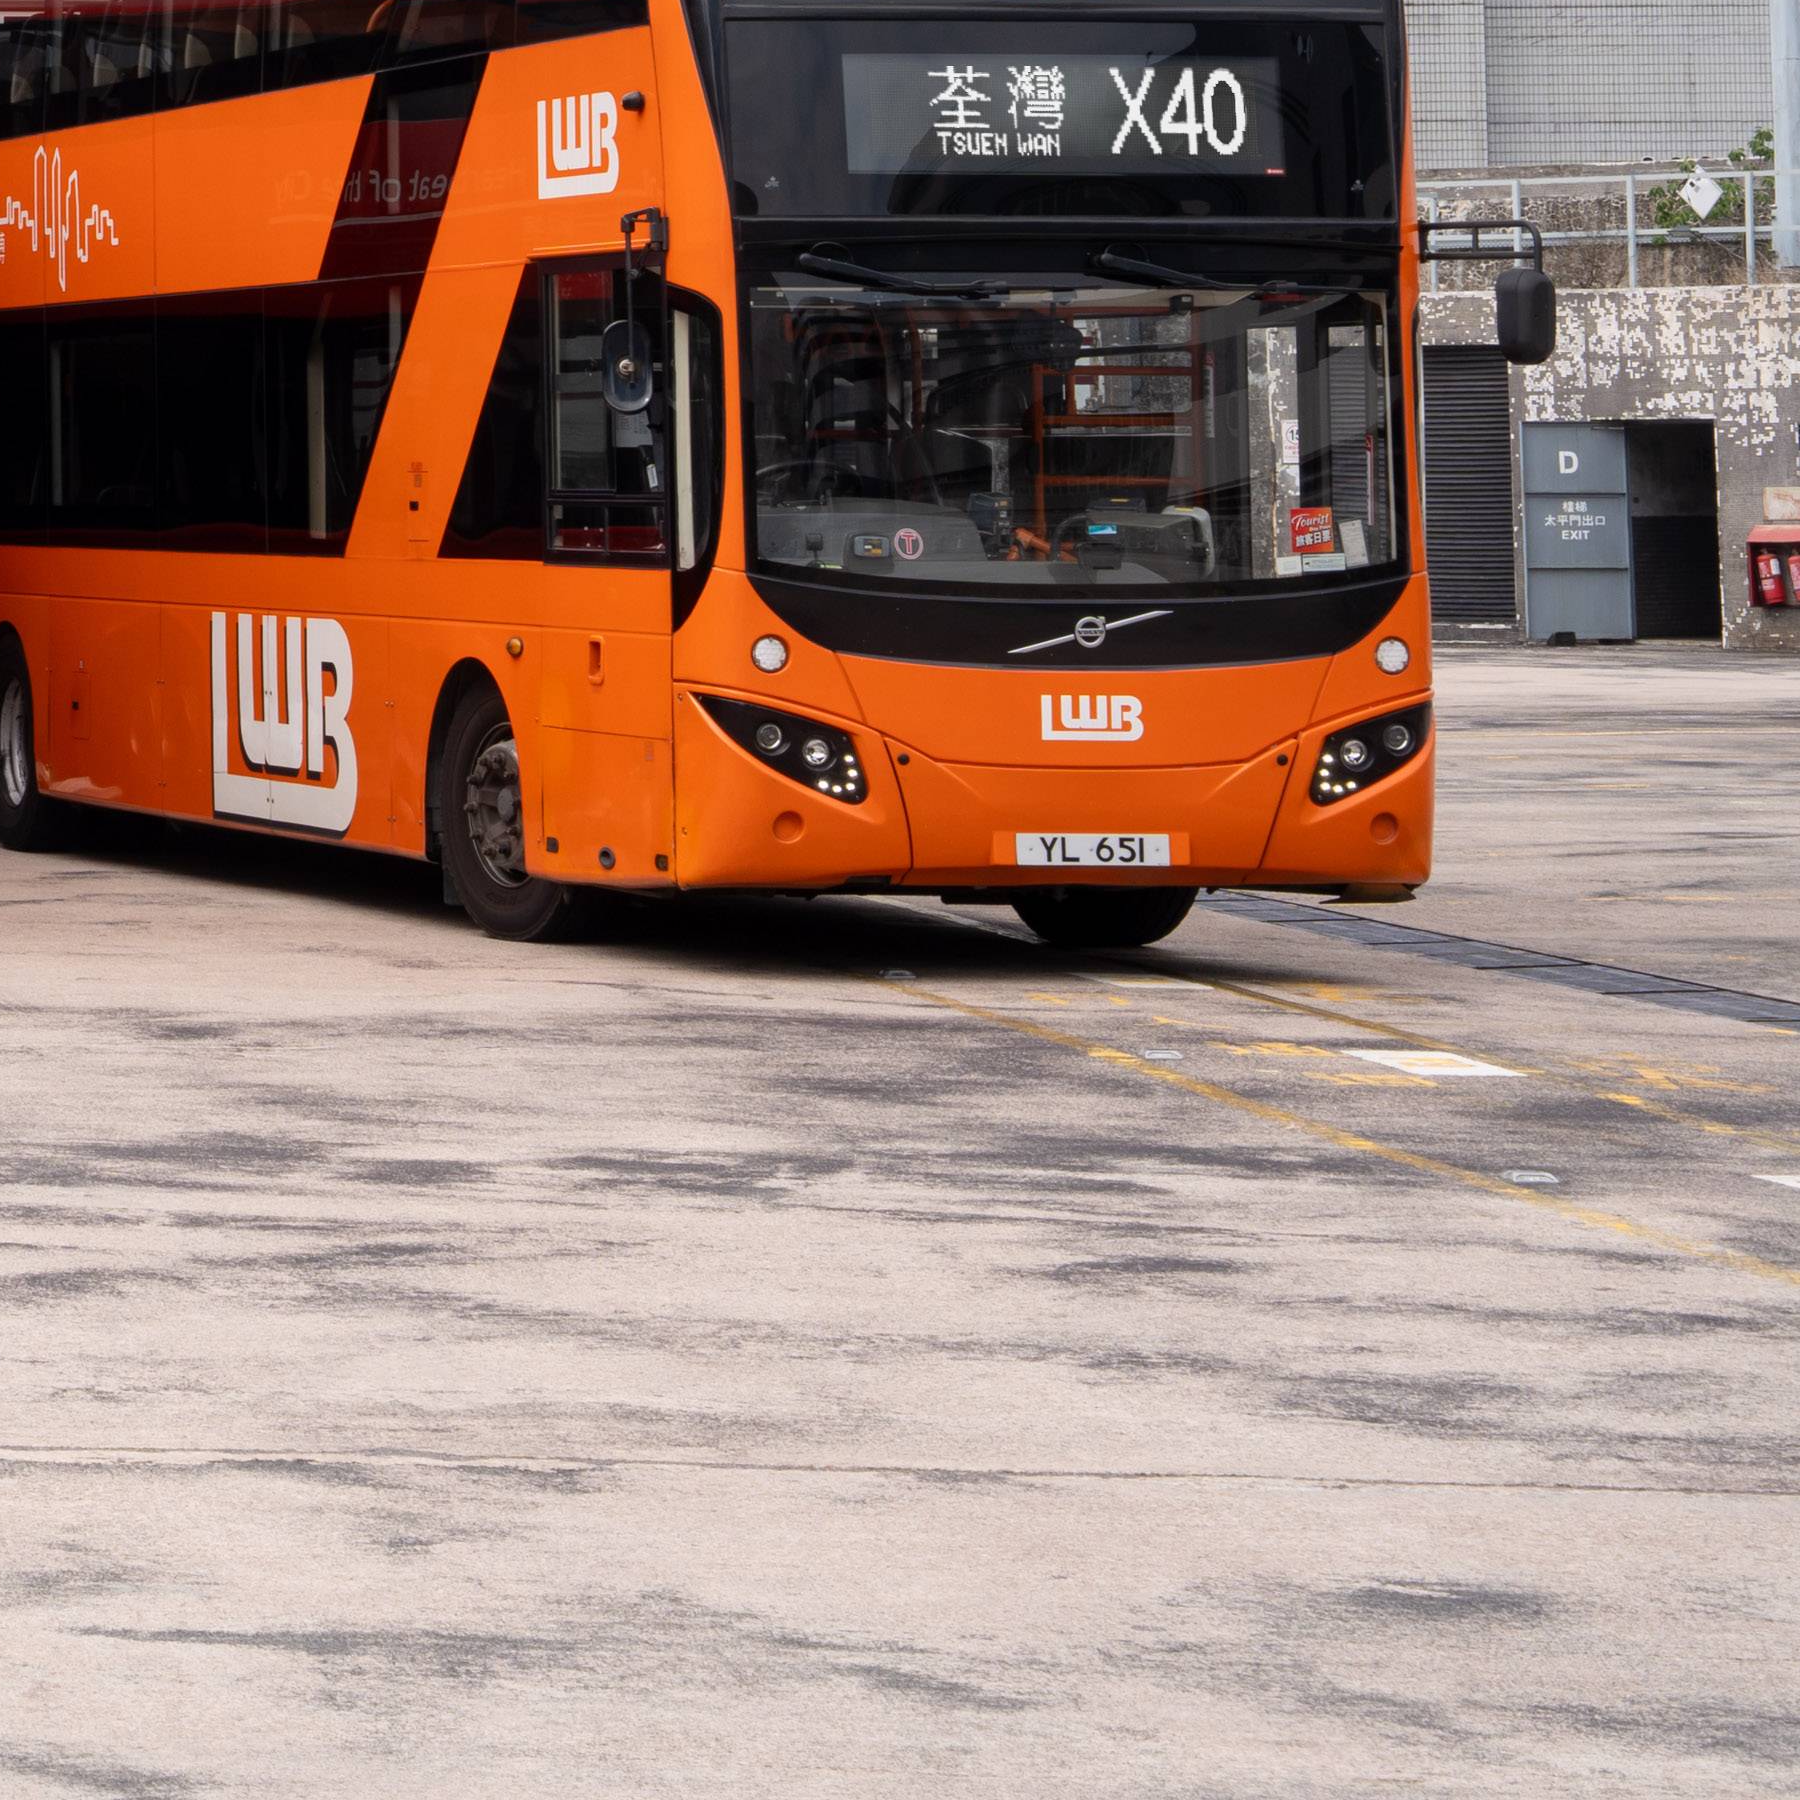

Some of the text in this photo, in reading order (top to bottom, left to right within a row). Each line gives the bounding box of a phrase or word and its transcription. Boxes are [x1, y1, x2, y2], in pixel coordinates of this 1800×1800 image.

[927, 65, 1066, 129] 荃灣
[1108, 66, 1247, 156] X40
[536, 90, 620, 201] LWB
[936, 130, 1061, 157] TSUEN WAN
[1558, 451, 1580, 475] D
[1291, 512, 1331, 532] Tourist
[1544, 514, 1606, 527] 太平門出口
[1561, 529, 1591, 540] EXIT
[209, 611, 359, 841] LWB
[1040, 694, 1145, 742] LWB
[1039, 836, 1145, 864] YL 651
